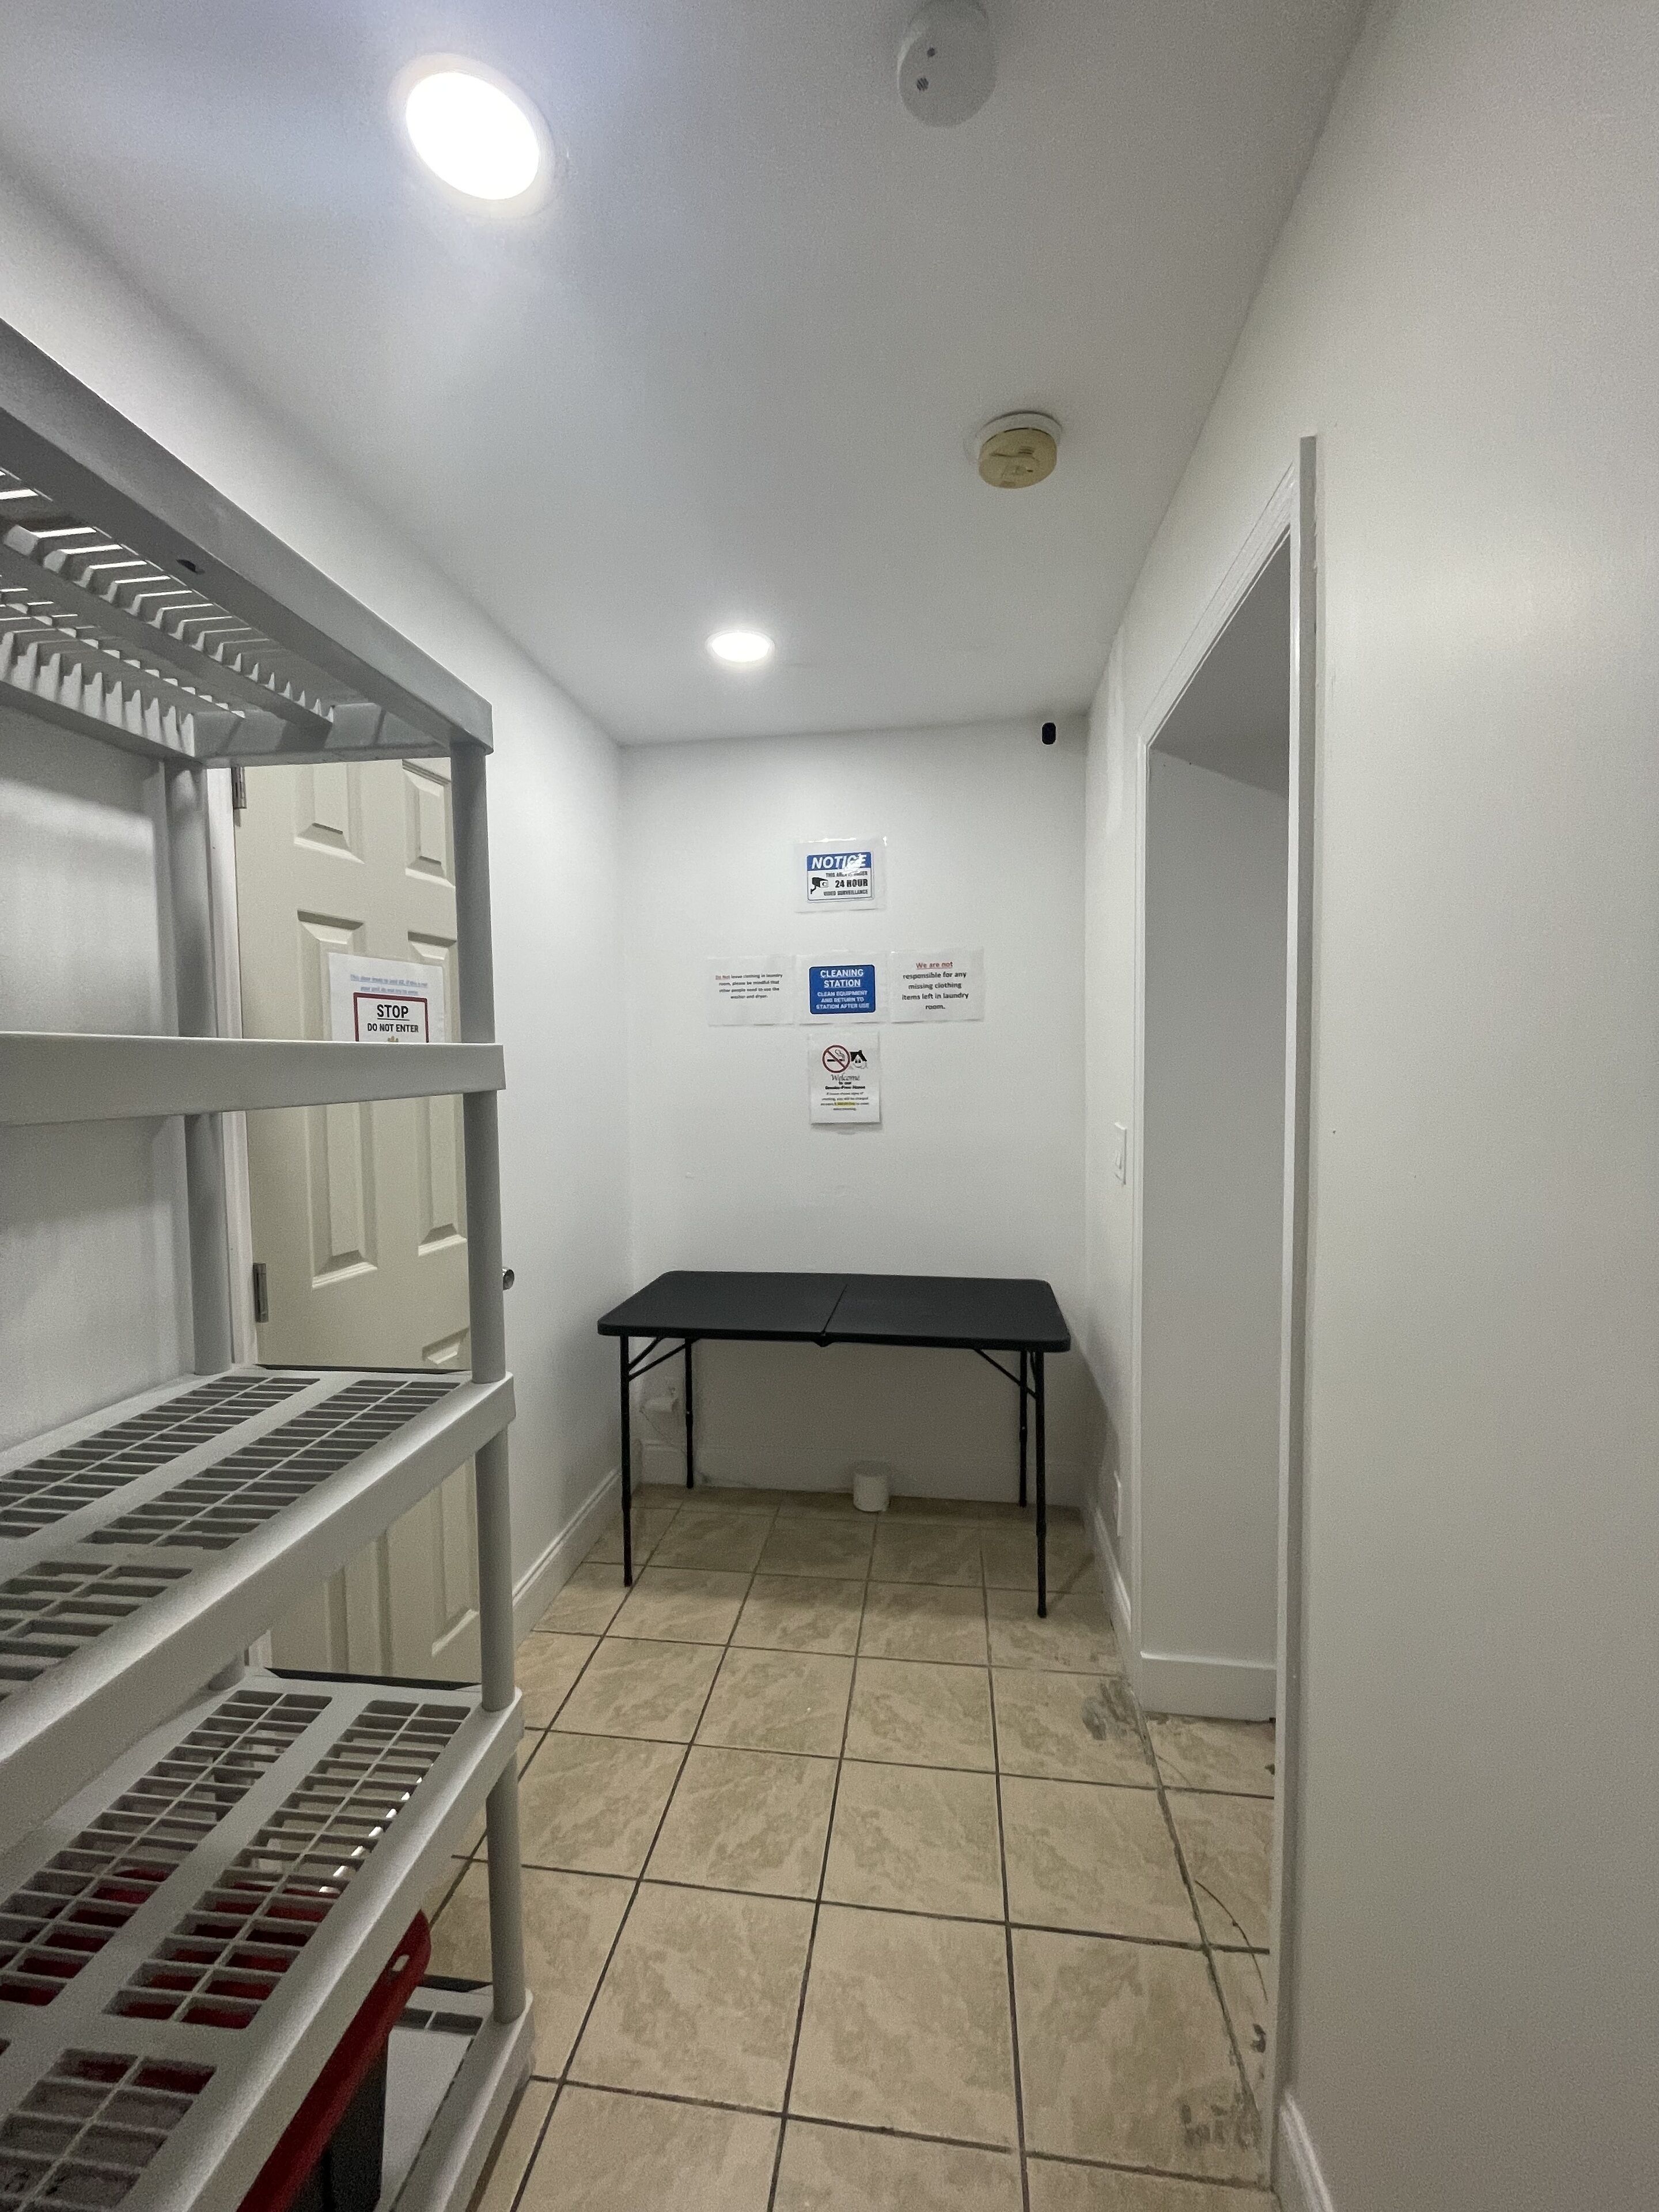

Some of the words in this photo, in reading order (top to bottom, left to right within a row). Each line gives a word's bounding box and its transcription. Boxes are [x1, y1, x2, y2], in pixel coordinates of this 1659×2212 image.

[812, 854, 867, 869] NOTICE
[835, 880, 844, 888] 24
[846, 879, 868, 887] HOUR
[820, 969, 863, 978] CLEANING
[903, 972, 941, 980] responsible
[824, 979, 861, 988] STATION
[377, 1004, 409, 1018] STOP
[367, 1023, 377, 1031] DO
[380, 1023, 394, 1032] NOT
[396, 1024, 419, 1033] ENTER
[831, 1073, 860, 1081] Welcome
